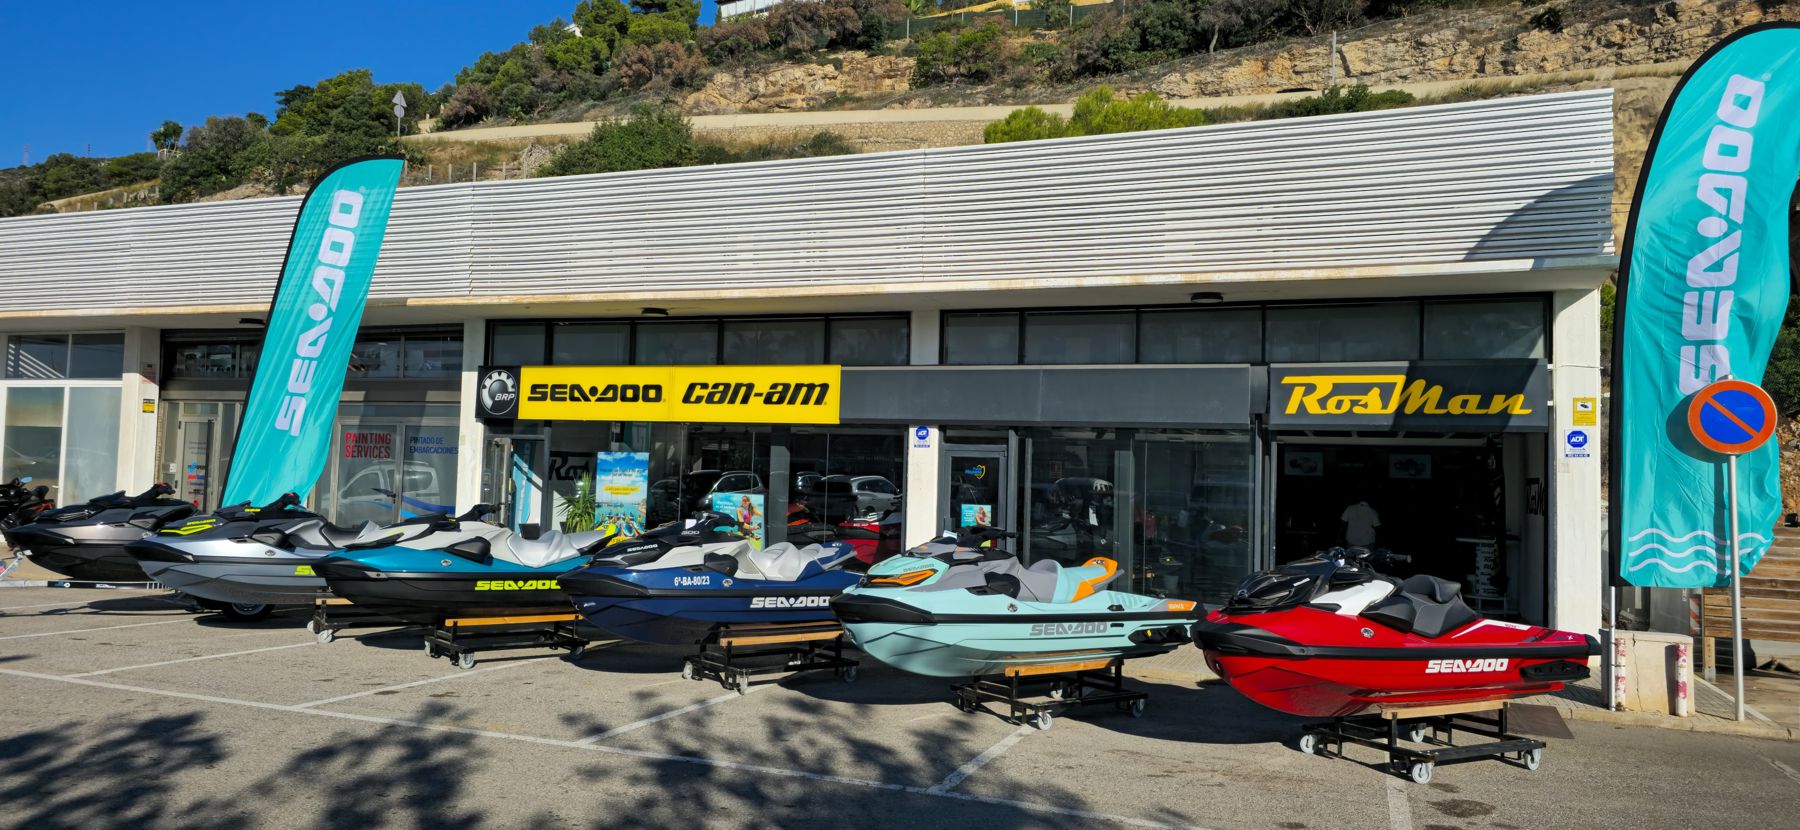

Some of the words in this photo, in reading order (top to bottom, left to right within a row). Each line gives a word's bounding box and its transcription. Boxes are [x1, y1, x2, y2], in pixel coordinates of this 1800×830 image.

[682, 382, 829, 405] can-am
[1281, 375, 1532, 414] RosMan
[345, 432, 391, 444] PAINTING
[345, 445, 390, 458] SERVICES
[410, 446, 458, 454] EMBARCACIONES
